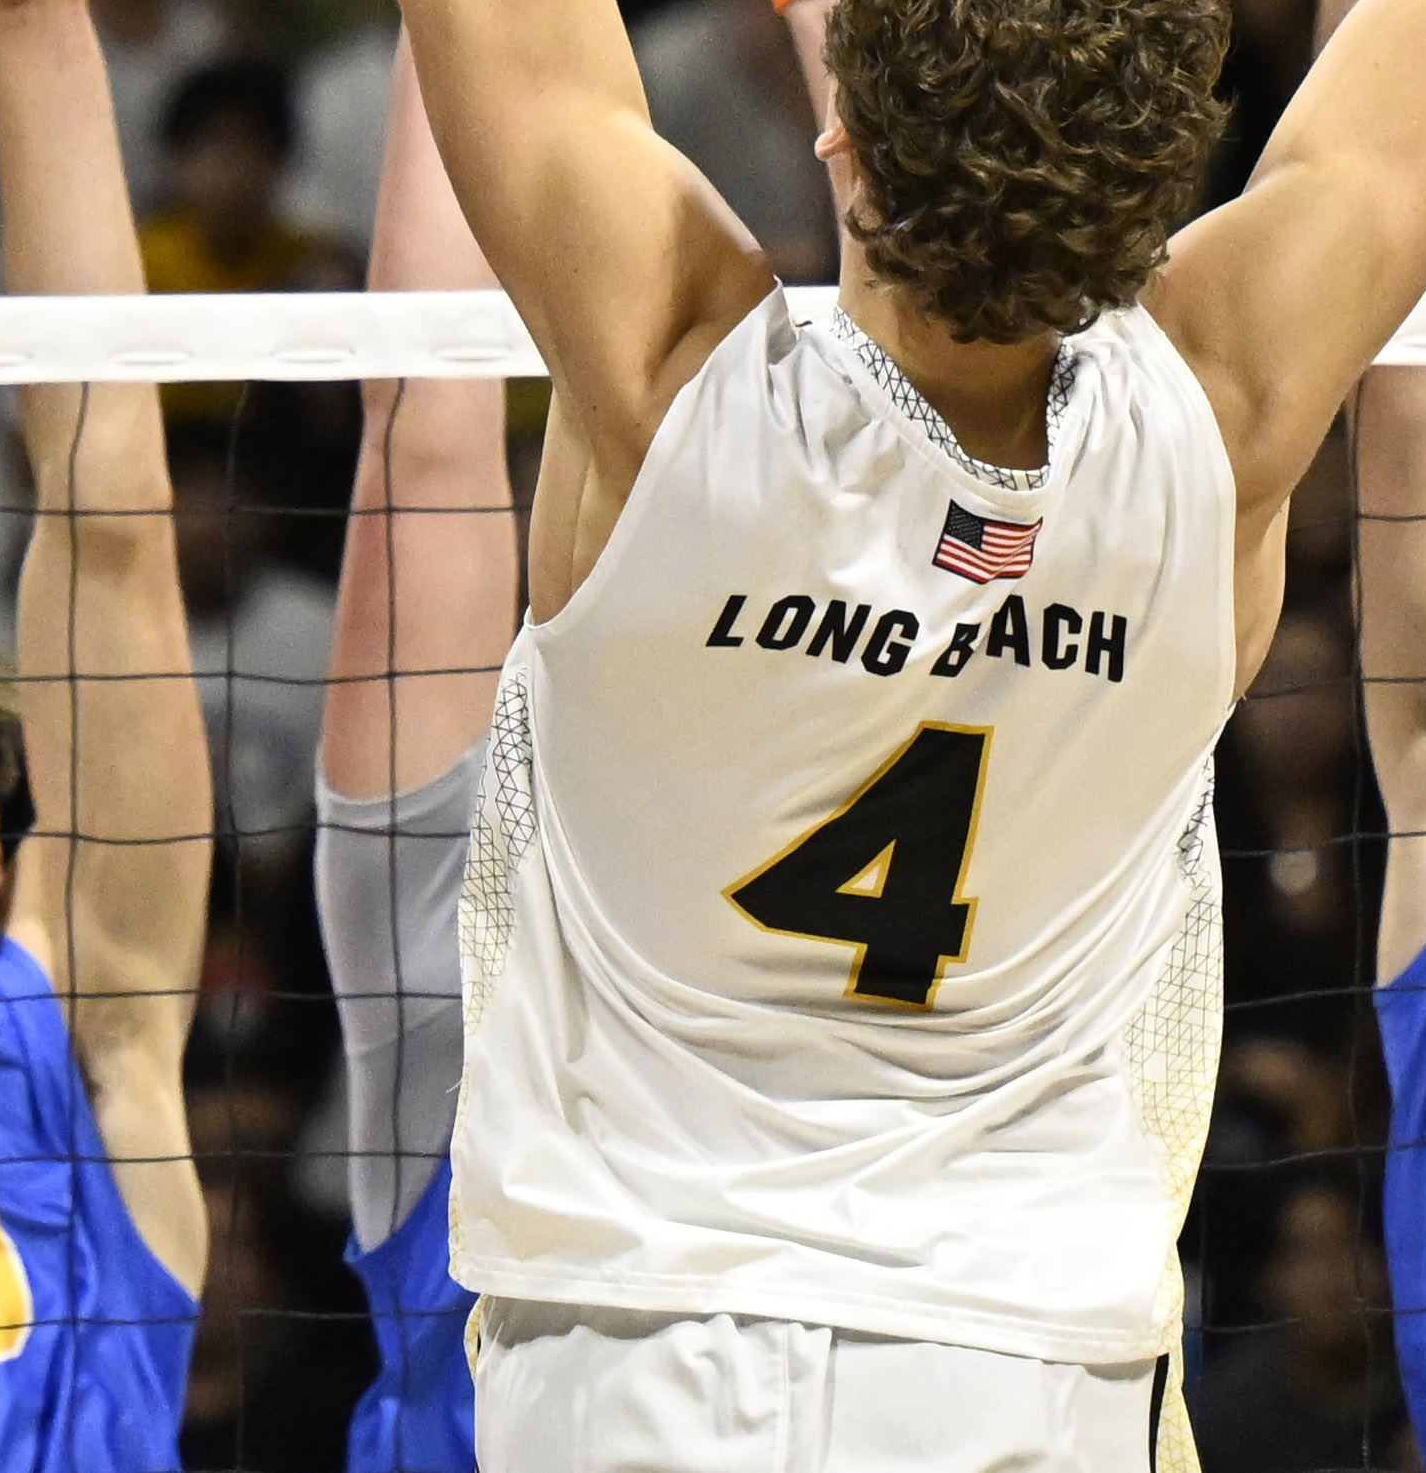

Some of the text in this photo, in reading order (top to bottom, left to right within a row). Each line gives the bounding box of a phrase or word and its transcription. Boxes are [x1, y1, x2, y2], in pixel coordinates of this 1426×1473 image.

[705, 594, 1127, 682] LONG BACH
[720, 720, 994, 1012] 4
